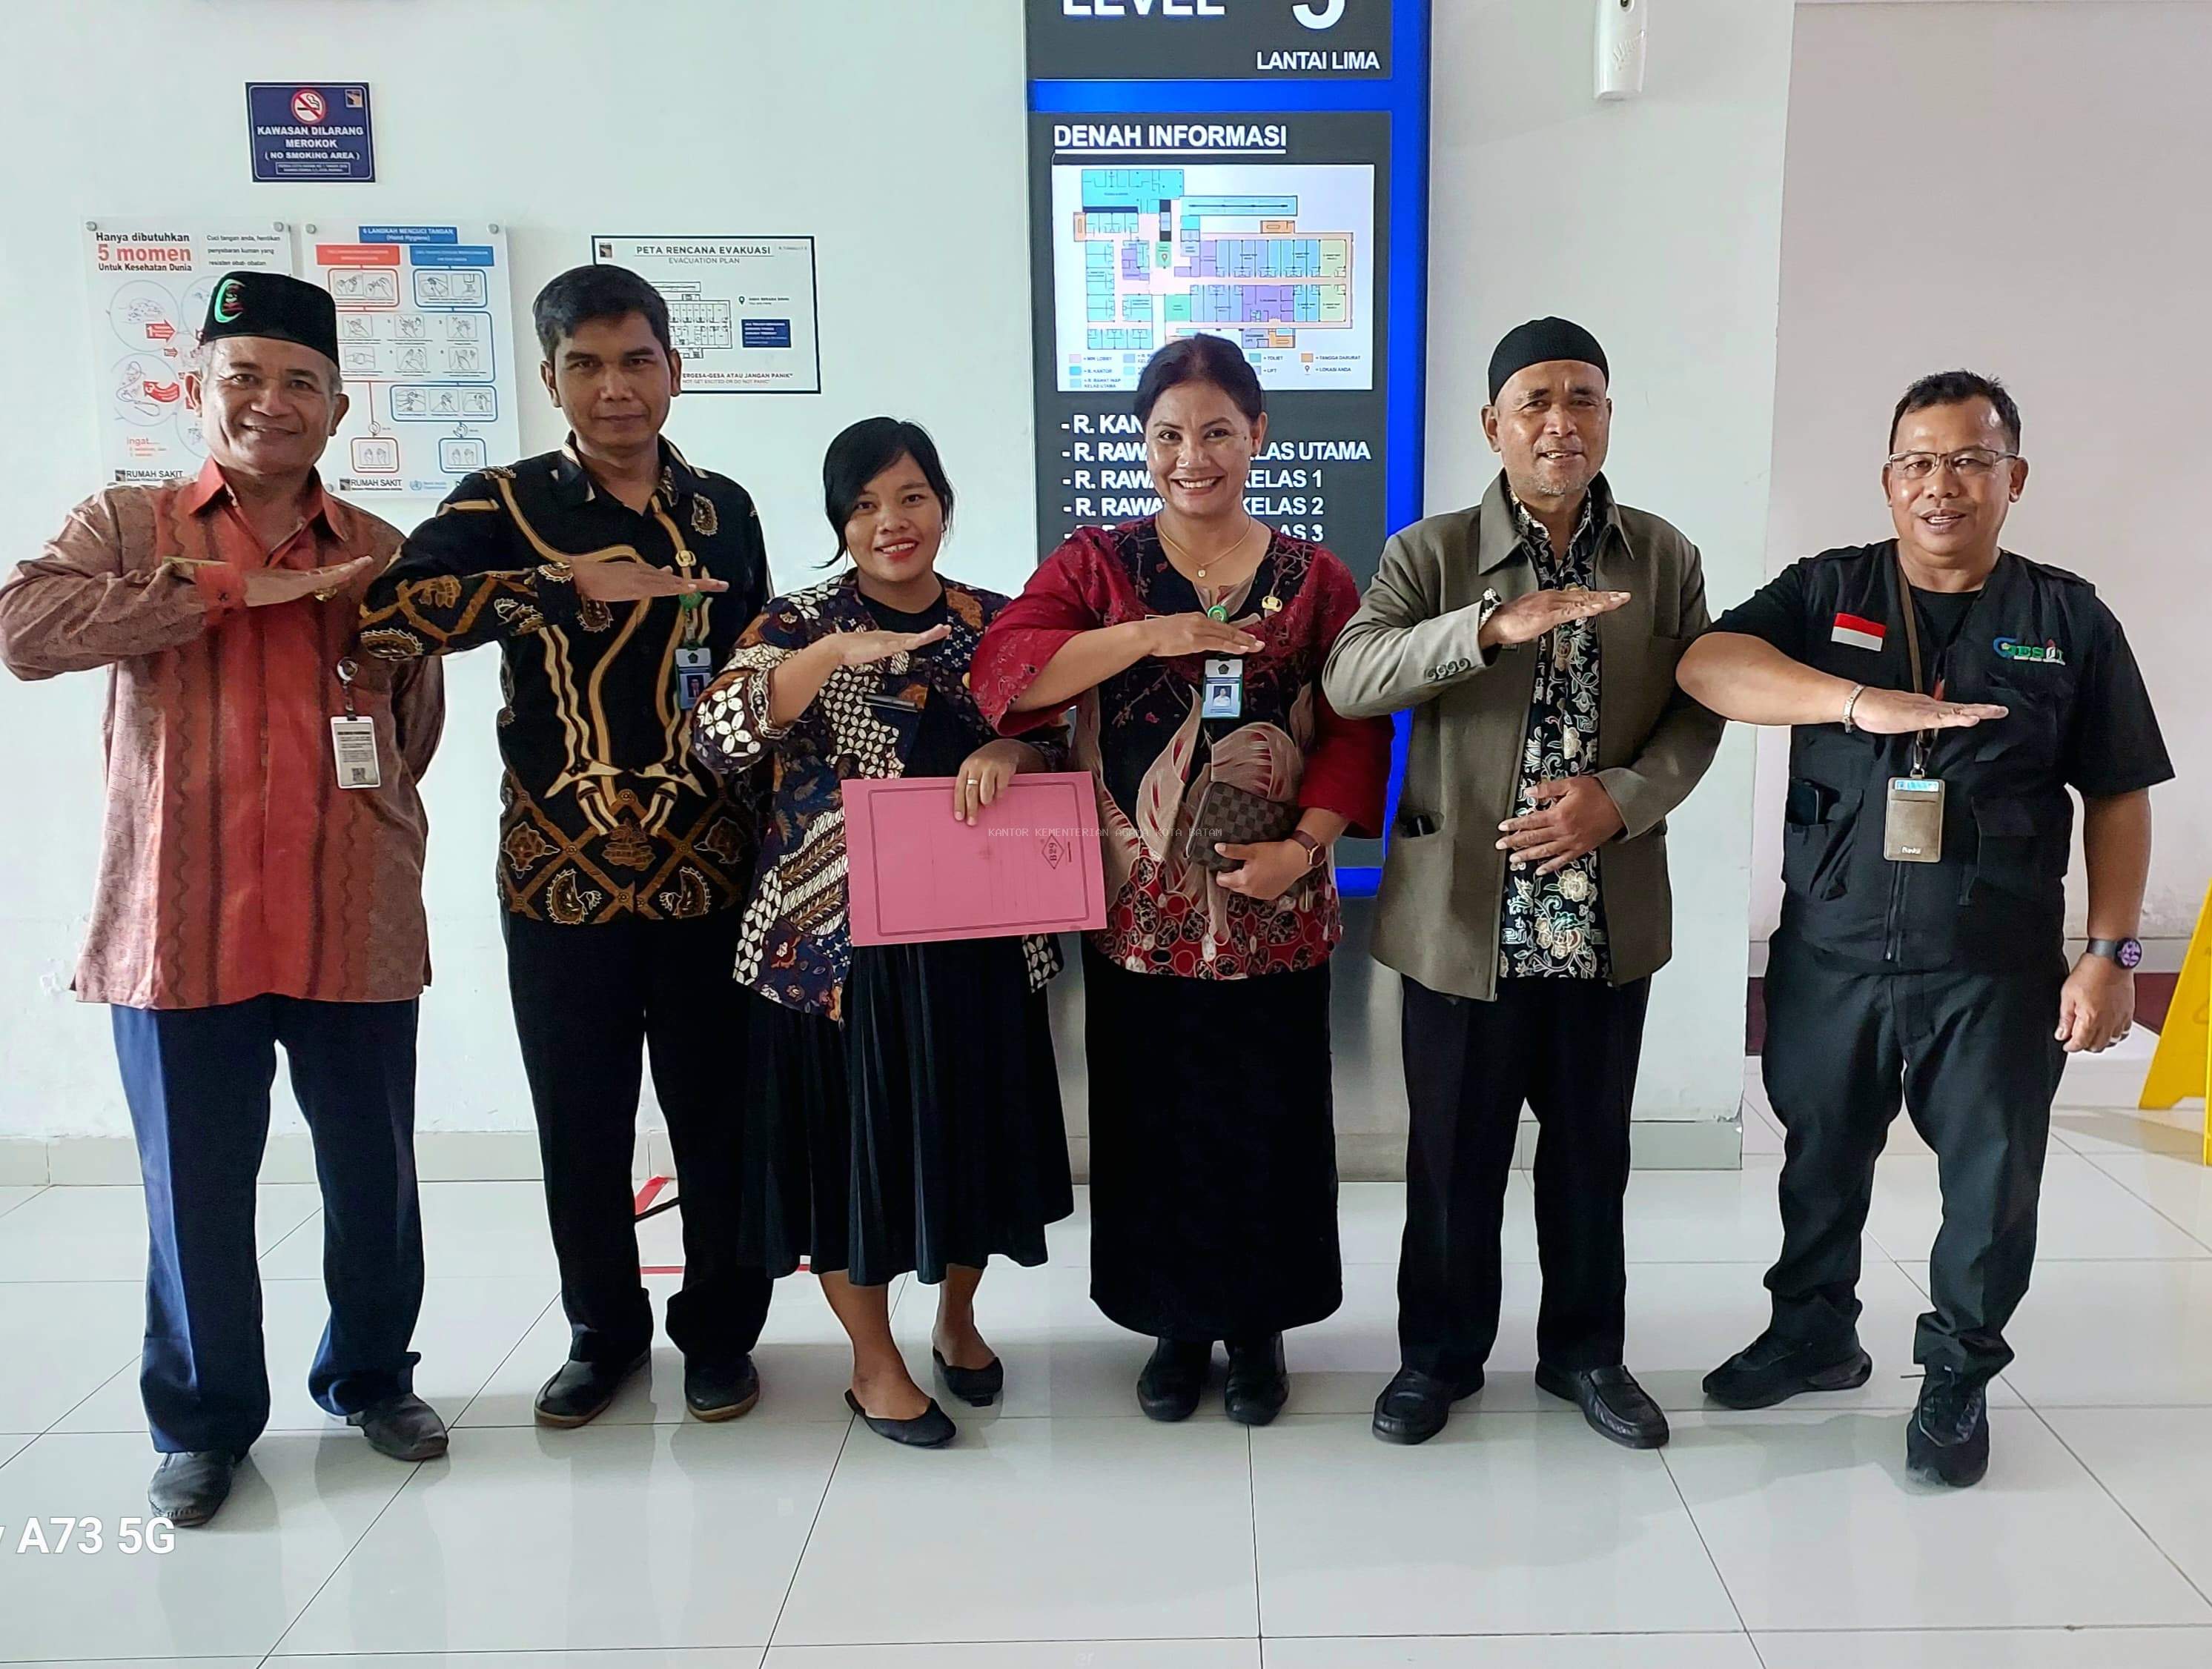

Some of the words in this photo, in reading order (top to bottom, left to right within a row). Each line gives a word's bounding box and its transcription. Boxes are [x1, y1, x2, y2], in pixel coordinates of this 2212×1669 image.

[1256, 52, 1327, 70] LANTAI
[1331, 51, 1380, 69] LIMA
[257, 126, 308, 135] KAWASAN
[311, 126, 363, 135] DILARANG
[1053, 125, 1141, 146] DENAH
[1148, 125, 1287, 146] INFORMASI
[285, 139, 338, 148] MEROKOK
[96, 232, 128, 243] Hanya
[131, 232, 190, 242] dibutuhkan
[98, 244, 109, 261] 5
[116, 248, 191, 261] momen
[666, 246, 716, 254] RENCANA
[719, 246, 771, 254] EVAKUASI
[169, 263, 192, 271] Dunia
[1073, 414, 1095, 434] R.
[1099, 414, 1144, 434] KAN
[1074, 442, 1095, 462] R.
[1098, 442, 1148, 462] RAW
[1299, 442, 1371, 460] UTAMA
[127, 470, 156, 478] RUMAH
[158, 470, 183, 478] SAKIT
[1075, 470, 1096, 488] R.
[1101, 470, 1154, 489] RAW
[1312, 469, 1322, 488] 1
[380, 479, 402, 487] SAKIT
[1076, 497, 1096, 517] R.
[1101, 497, 1165, 517] RAWA
[1311, 497, 1324, 515] 2
[1311, 524, 1323, 542] 3
